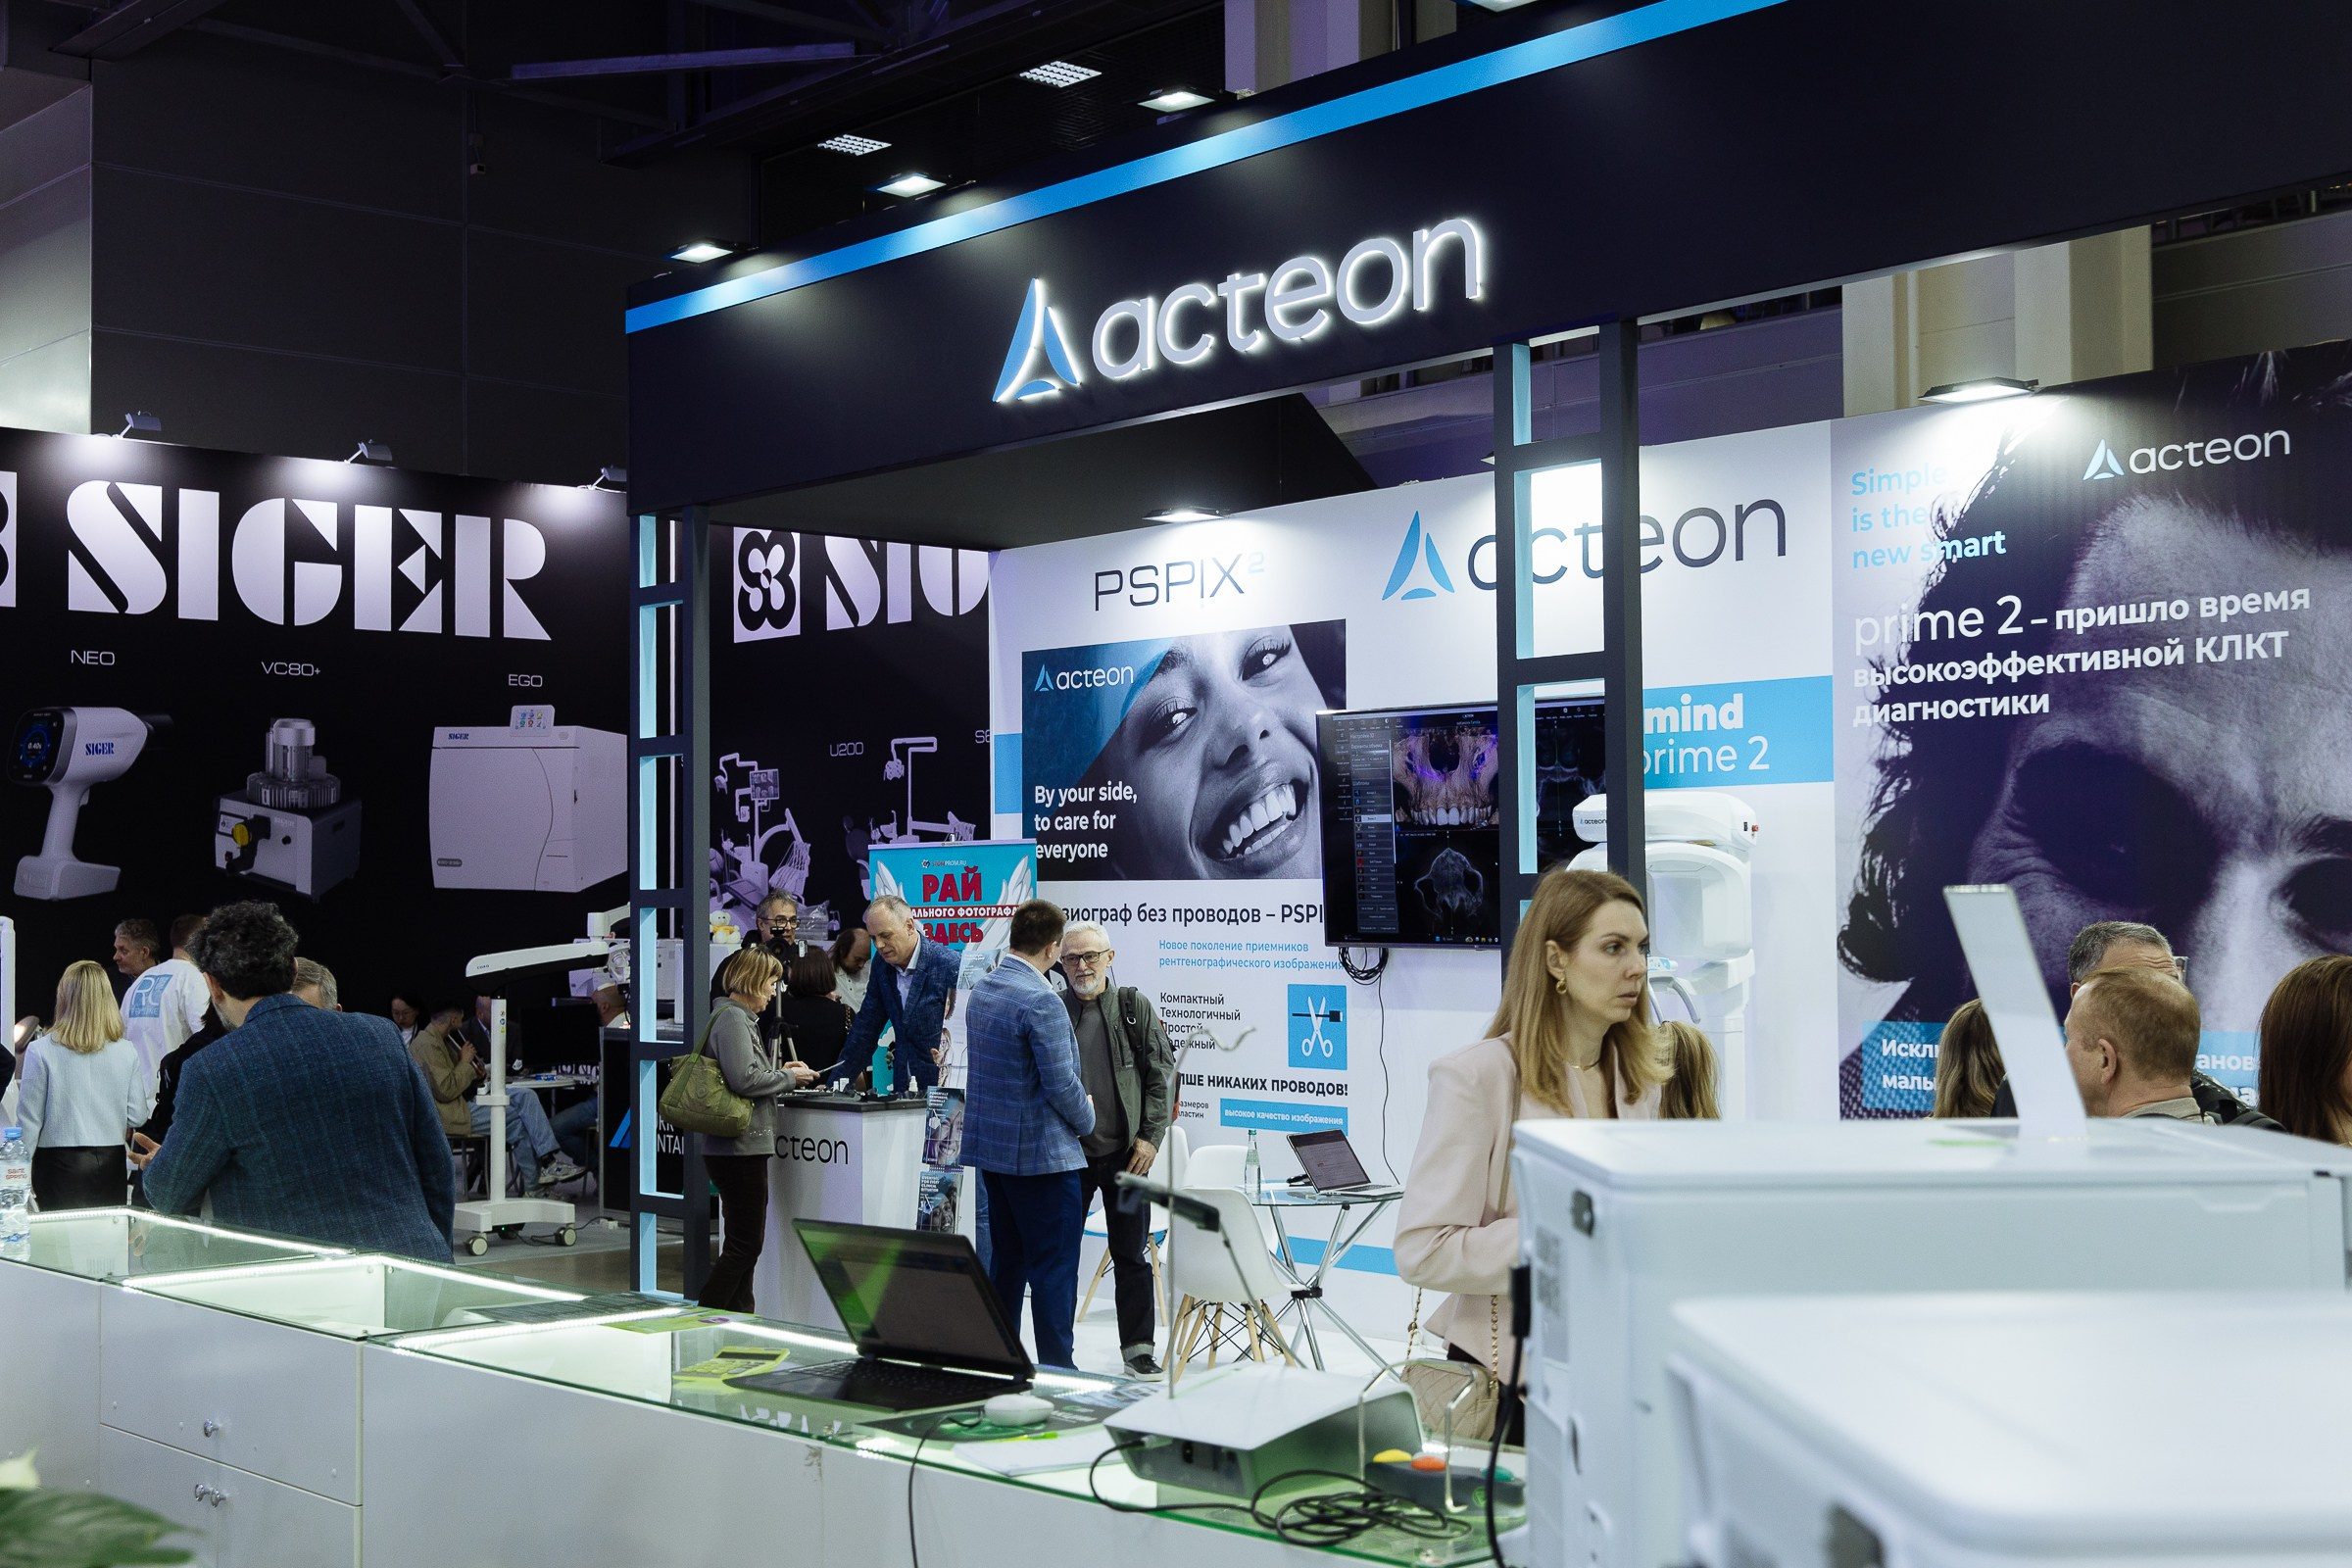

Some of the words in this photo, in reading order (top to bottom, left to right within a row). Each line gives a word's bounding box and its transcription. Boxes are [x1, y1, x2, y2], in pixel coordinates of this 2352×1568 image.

[1092, 219, 1482, 379] acteon
[2129, 429, 2290, 475] acteon
[1851, 463, 1948, 497] Simple
[1852, 508, 1872, 532] is
[1882, 505, 1927, 528] the
[67, 479, 552, 640] SIGER
[1852, 543, 1911, 568] new
[1920, 530, 2006, 564] smart
[1855, 602, 1984, 655] prime
[1996, 594, 2025, 635] 2
[2055, 596, 2189, 634] пришло
[2199, 588, 2310, 622] время
[71, 650, 115, 666] NEO
[1853, 638, 2184, 688] высокоэффективной
[2195, 630, 2289, 663] КЛКТ
[261, 662, 321, 677] VC80+
[509, 673, 543, 688] EGO
[1056, 665, 1134, 690] acteon
[1644, 692, 1743, 734] mind
[1852, 692, 2049, 727] диагностики
[85, 742, 115, 756] SIGER
[829, 742, 864, 757] U200
[1748, 736, 1770, 771] 2
[1035, 785, 1054, 808] By
[1058, 785, 1095, 808] your
[1099, 781, 1138, 804] side,
[1035, 813, 1050, 831] to
[1054, 813, 1088, 831] care
[1093, 809, 1116, 830] for
[1036, 840, 1108, 863] everyone
[922, 865, 983, 904] РАЙ
[911, 906, 956, 918] АЛЬНОГО
[1061, 903, 1132, 927] зиограф
[1137, 902, 1167, 923] без
[1172, 907, 1262, 927] проводов
[1281, 905, 1323, 923] PSPI
[922, 922, 984, 946] ЗДЕСЬ
[1159, 939, 1188, 952] Новое
[1191, 942, 1243, 952] поколение
[1246, 942, 1309, 954] приемников
[1159, 956, 1271, 969] рентгенографического
[1273, 959, 1343, 970] изображения
[1160, 992, 1224, 1004] Компактный
[1160, 1006, 1241, 1021] Технологичный
[1169, 1038, 1215, 1050] адежный
[2196, 1054, 2255, 1071] анов
[1207, 1075, 1267, 1091] НИКАКИХ
[1272, 1079, 1348, 1097] ПРОВОДОВ!
[1883, 1075, 1937, 1091] малы
[1179, 1110, 1203, 1119] ластин
[1180, 1101, 1209, 1110] азмеров
[1225, 1108, 1254, 1119] высокое
[1256, 1111, 1290, 1122] качество
[1292, 1114, 1343, 1125] изображения
[658, 1134, 684, 1154] NTA
[775, 1135, 848, 1164] cteon
